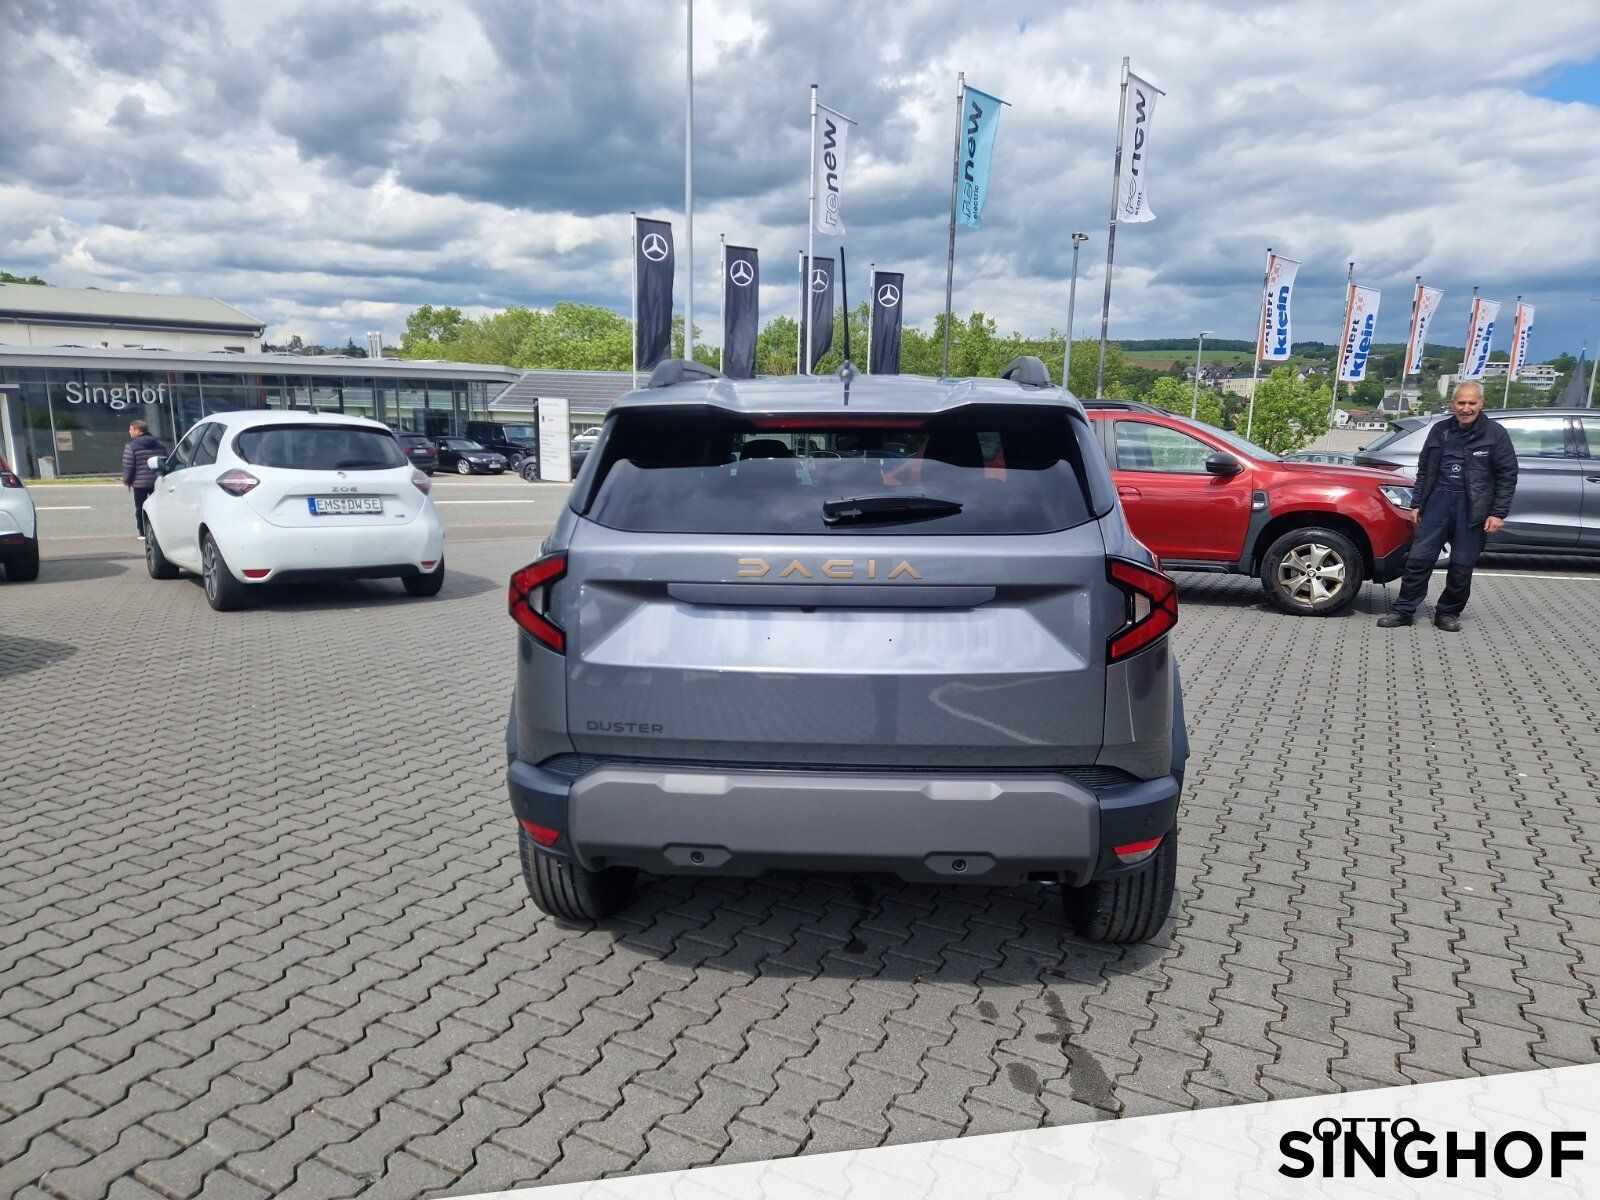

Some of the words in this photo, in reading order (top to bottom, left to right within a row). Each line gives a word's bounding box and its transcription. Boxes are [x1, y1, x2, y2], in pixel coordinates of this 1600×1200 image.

[823, 118, 839, 227] renew
[961, 100, 983, 218] renew
[1125, 88, 1146, 215] renew
[972, 185, 980, 220] electric
[1273, 285, 1290, 355] klein
[1349, 313, 1374, 377] klein
[65, 381, 166, 410] Singhof
[317, 499, 341, 510] EMS
[737, 557, 923, 580] DACIA
[586, 719, 665, 735] DUSTER
